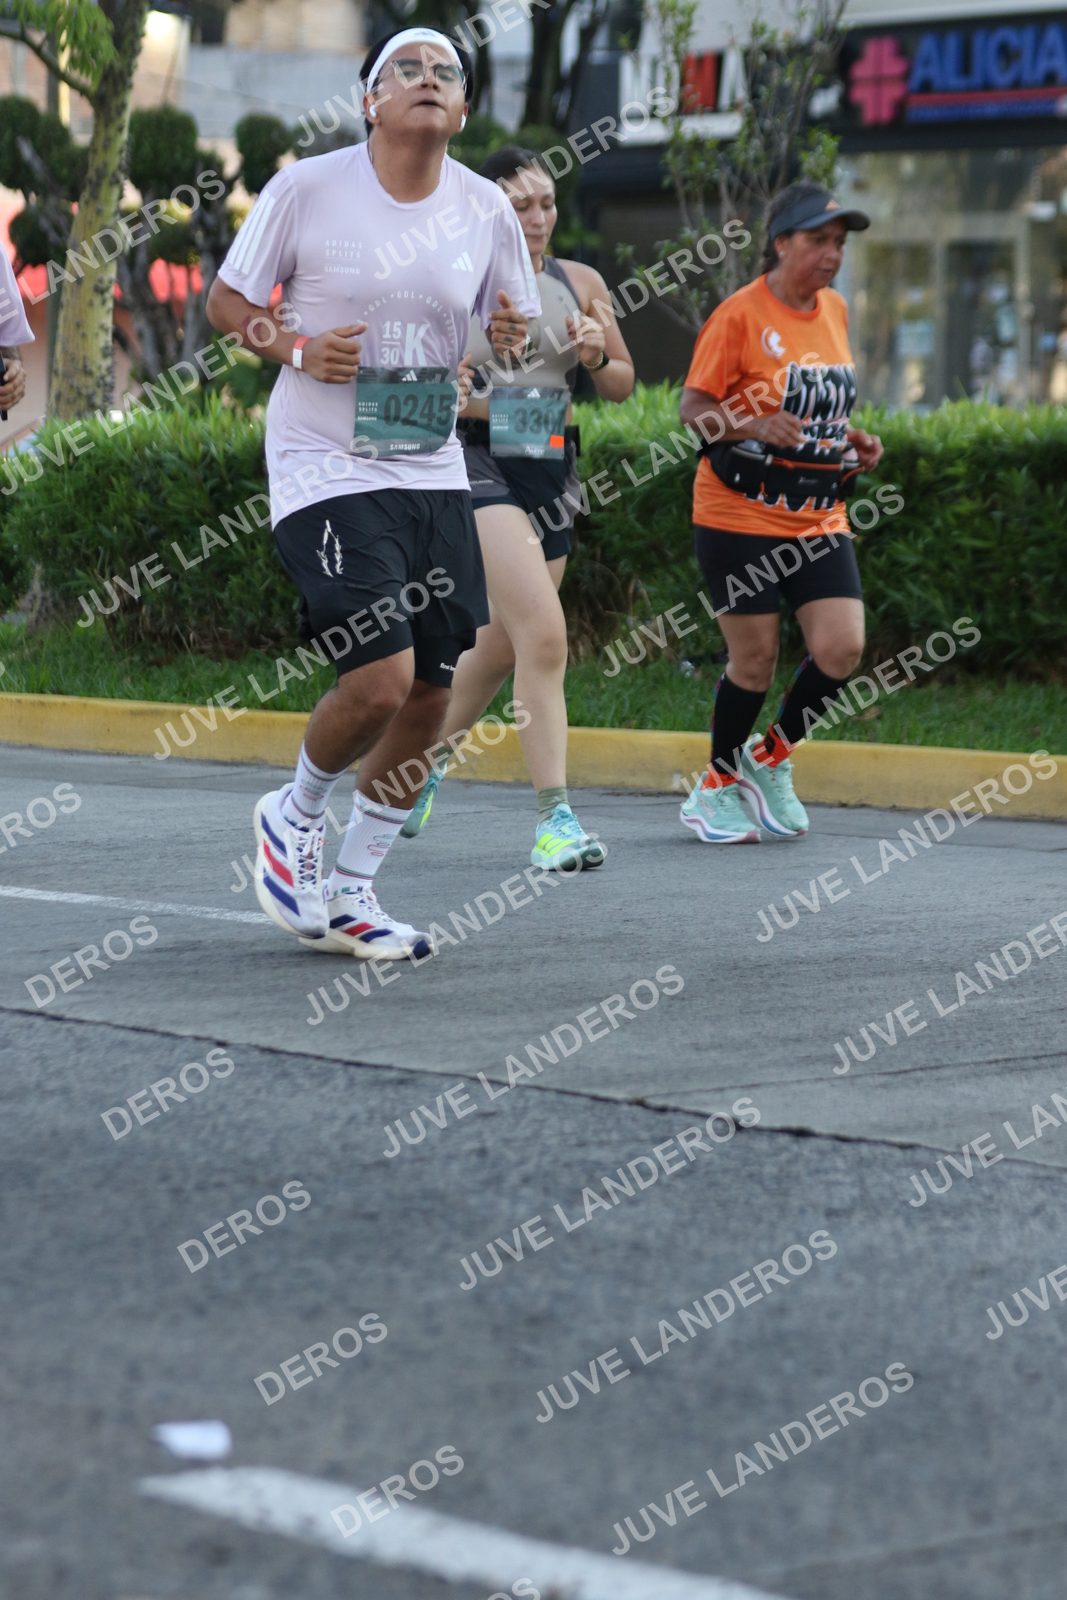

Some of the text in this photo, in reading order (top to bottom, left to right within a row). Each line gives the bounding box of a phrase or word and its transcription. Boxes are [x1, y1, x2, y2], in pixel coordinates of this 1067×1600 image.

[908, 21, 1067, 93] ALICIA
[382, 320, 401, 339] 15
[380, 346, 400, 366] 30
[403, 322, 431, 366] K
[383, 393, 453, 427] 0245
[389, 443, 421, 451] SAMSUNG
